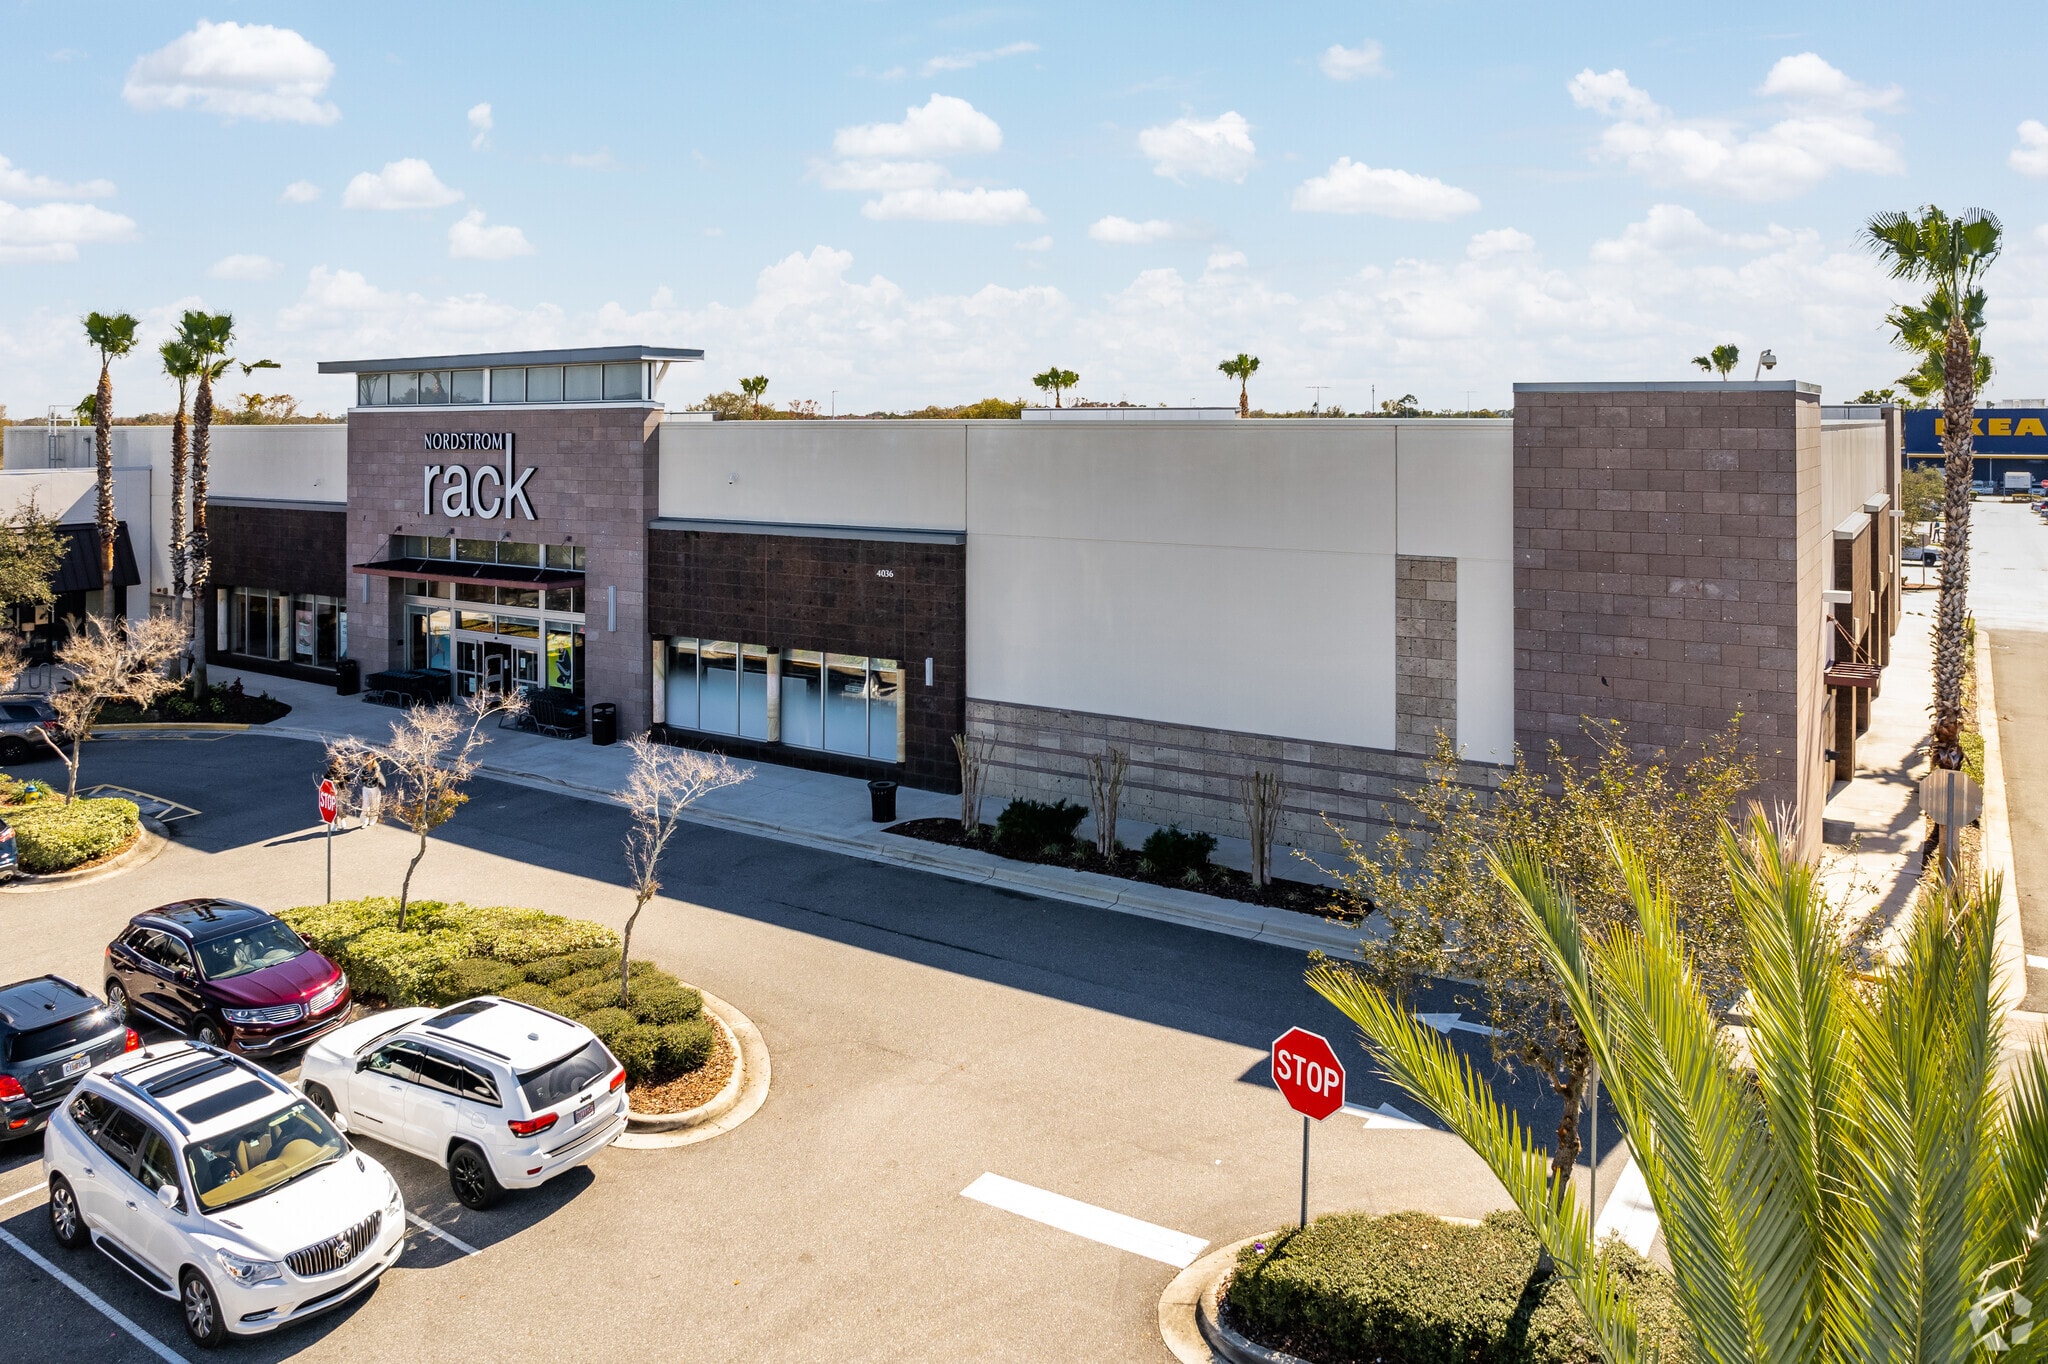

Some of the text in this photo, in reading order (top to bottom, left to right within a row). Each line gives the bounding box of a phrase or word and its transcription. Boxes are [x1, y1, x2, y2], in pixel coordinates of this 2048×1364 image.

[424, 432, 504, 451] NORDSTROM
[423, 432, 537, 521] rack
[876, 569, 894, 578] 4036
[320, 791, 336, 811] STOP
[1276, 1049, 1340, 1098] STOP
